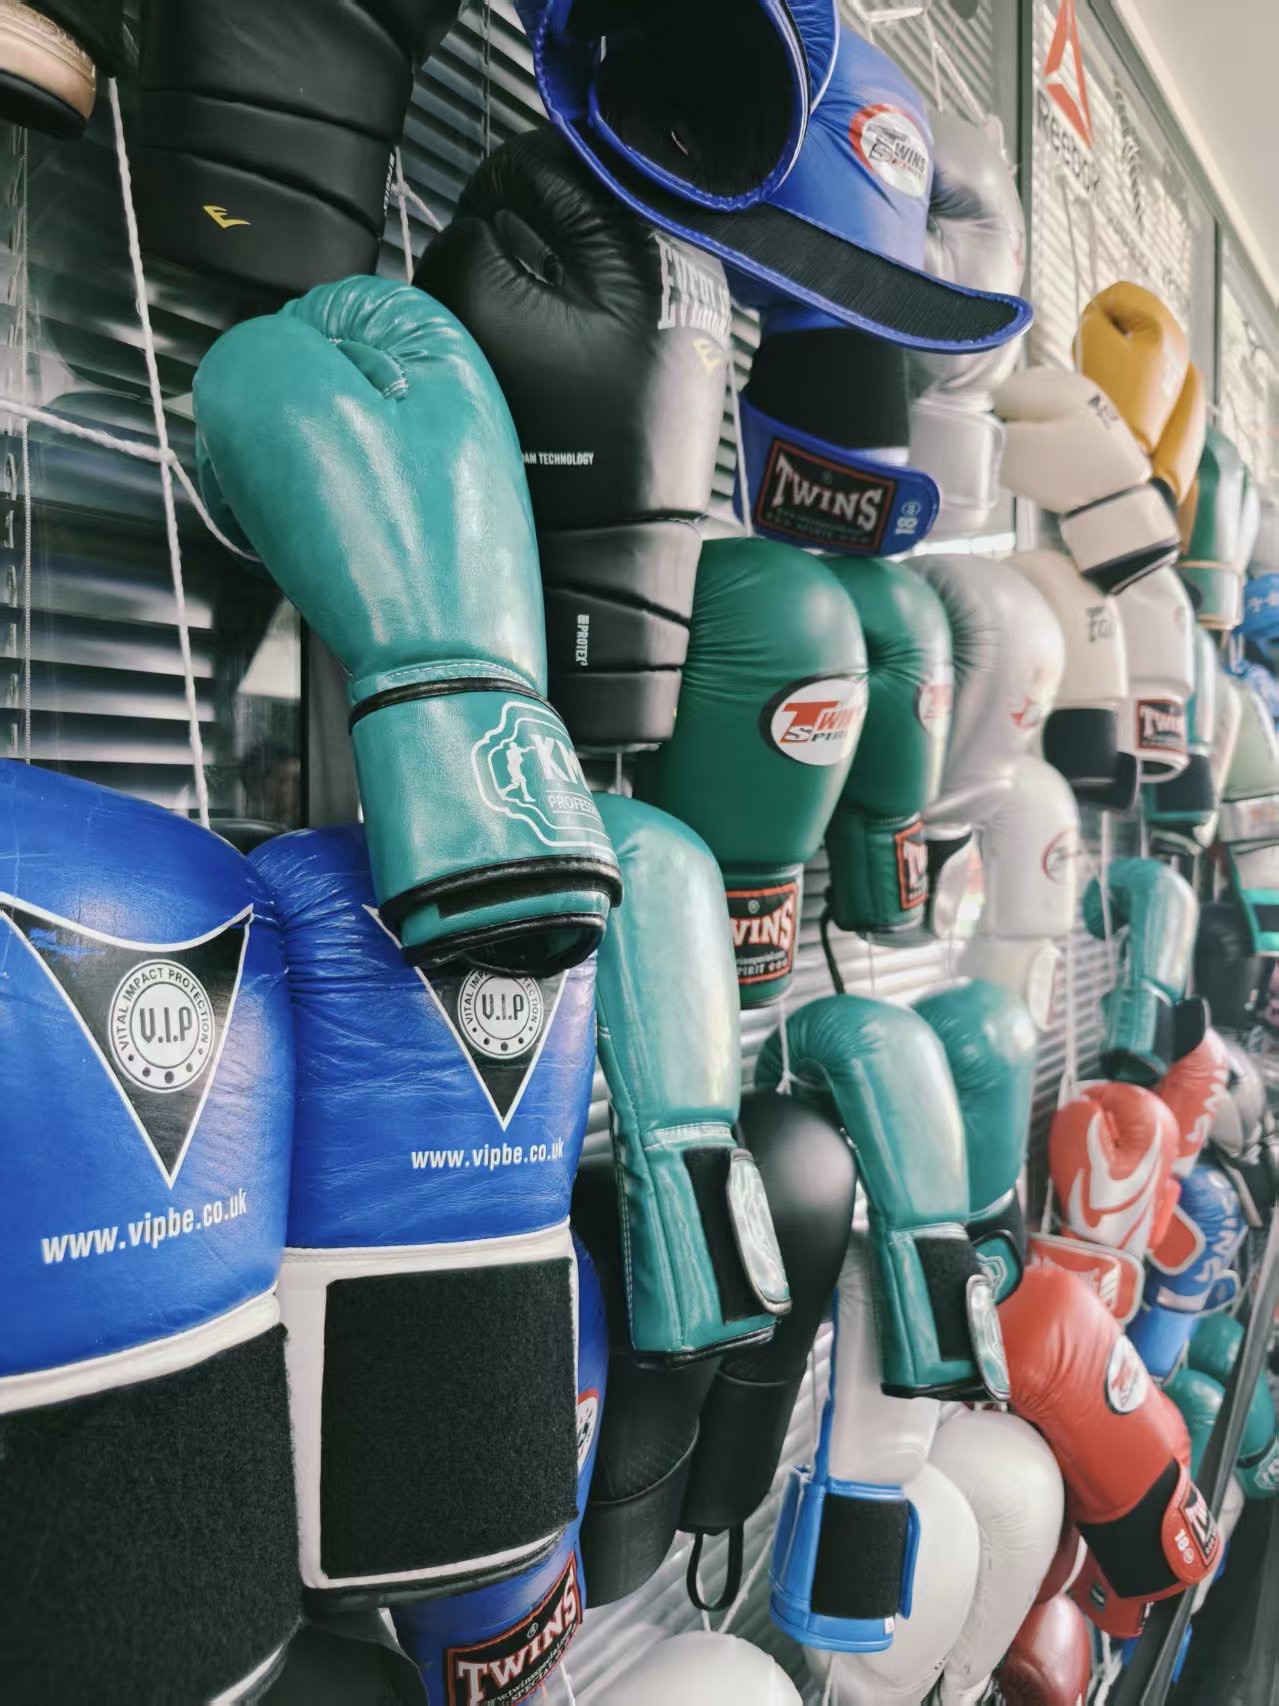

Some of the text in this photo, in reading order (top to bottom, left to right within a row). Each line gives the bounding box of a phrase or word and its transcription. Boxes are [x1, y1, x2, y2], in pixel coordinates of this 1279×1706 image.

[523, 452, 594, 465] AM TECHNOLOGY
[771, 453, 884, 533] TWINS
[780, 700, 866, 743] TWIN
[730, 894, 795, 952] WINS
[116, 967, 210, 1052] VITAL IMPACT PROTECTION
[463, 991, 475, 1025] VITAL
[411, 1136, 564, 1171] www.vipbe.co.uk
[41, 1188, 247, 1264] www.vipbe.co.uk
[456, 1565, 576, 1706] TWINS
